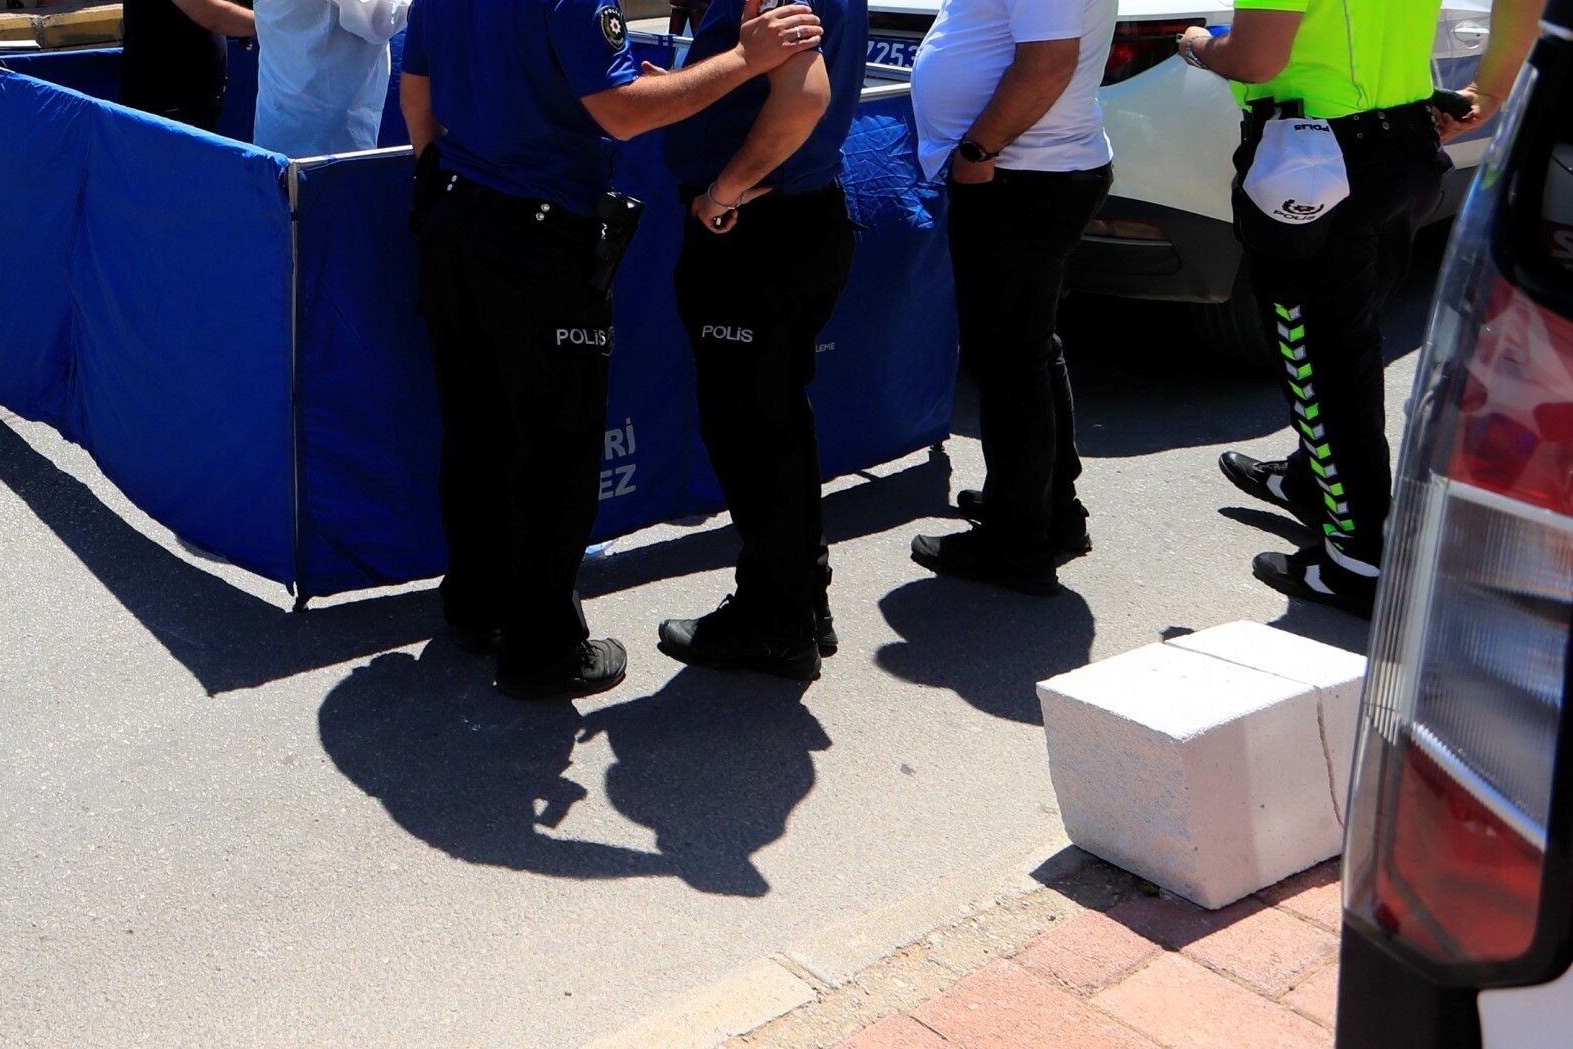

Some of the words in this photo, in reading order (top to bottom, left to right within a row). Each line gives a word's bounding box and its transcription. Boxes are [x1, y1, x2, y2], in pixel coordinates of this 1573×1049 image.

[815, 342, 836, 353] LEME
[604, 417, 637, 460] Rİ
[598, 463, 637, 500] EZ
